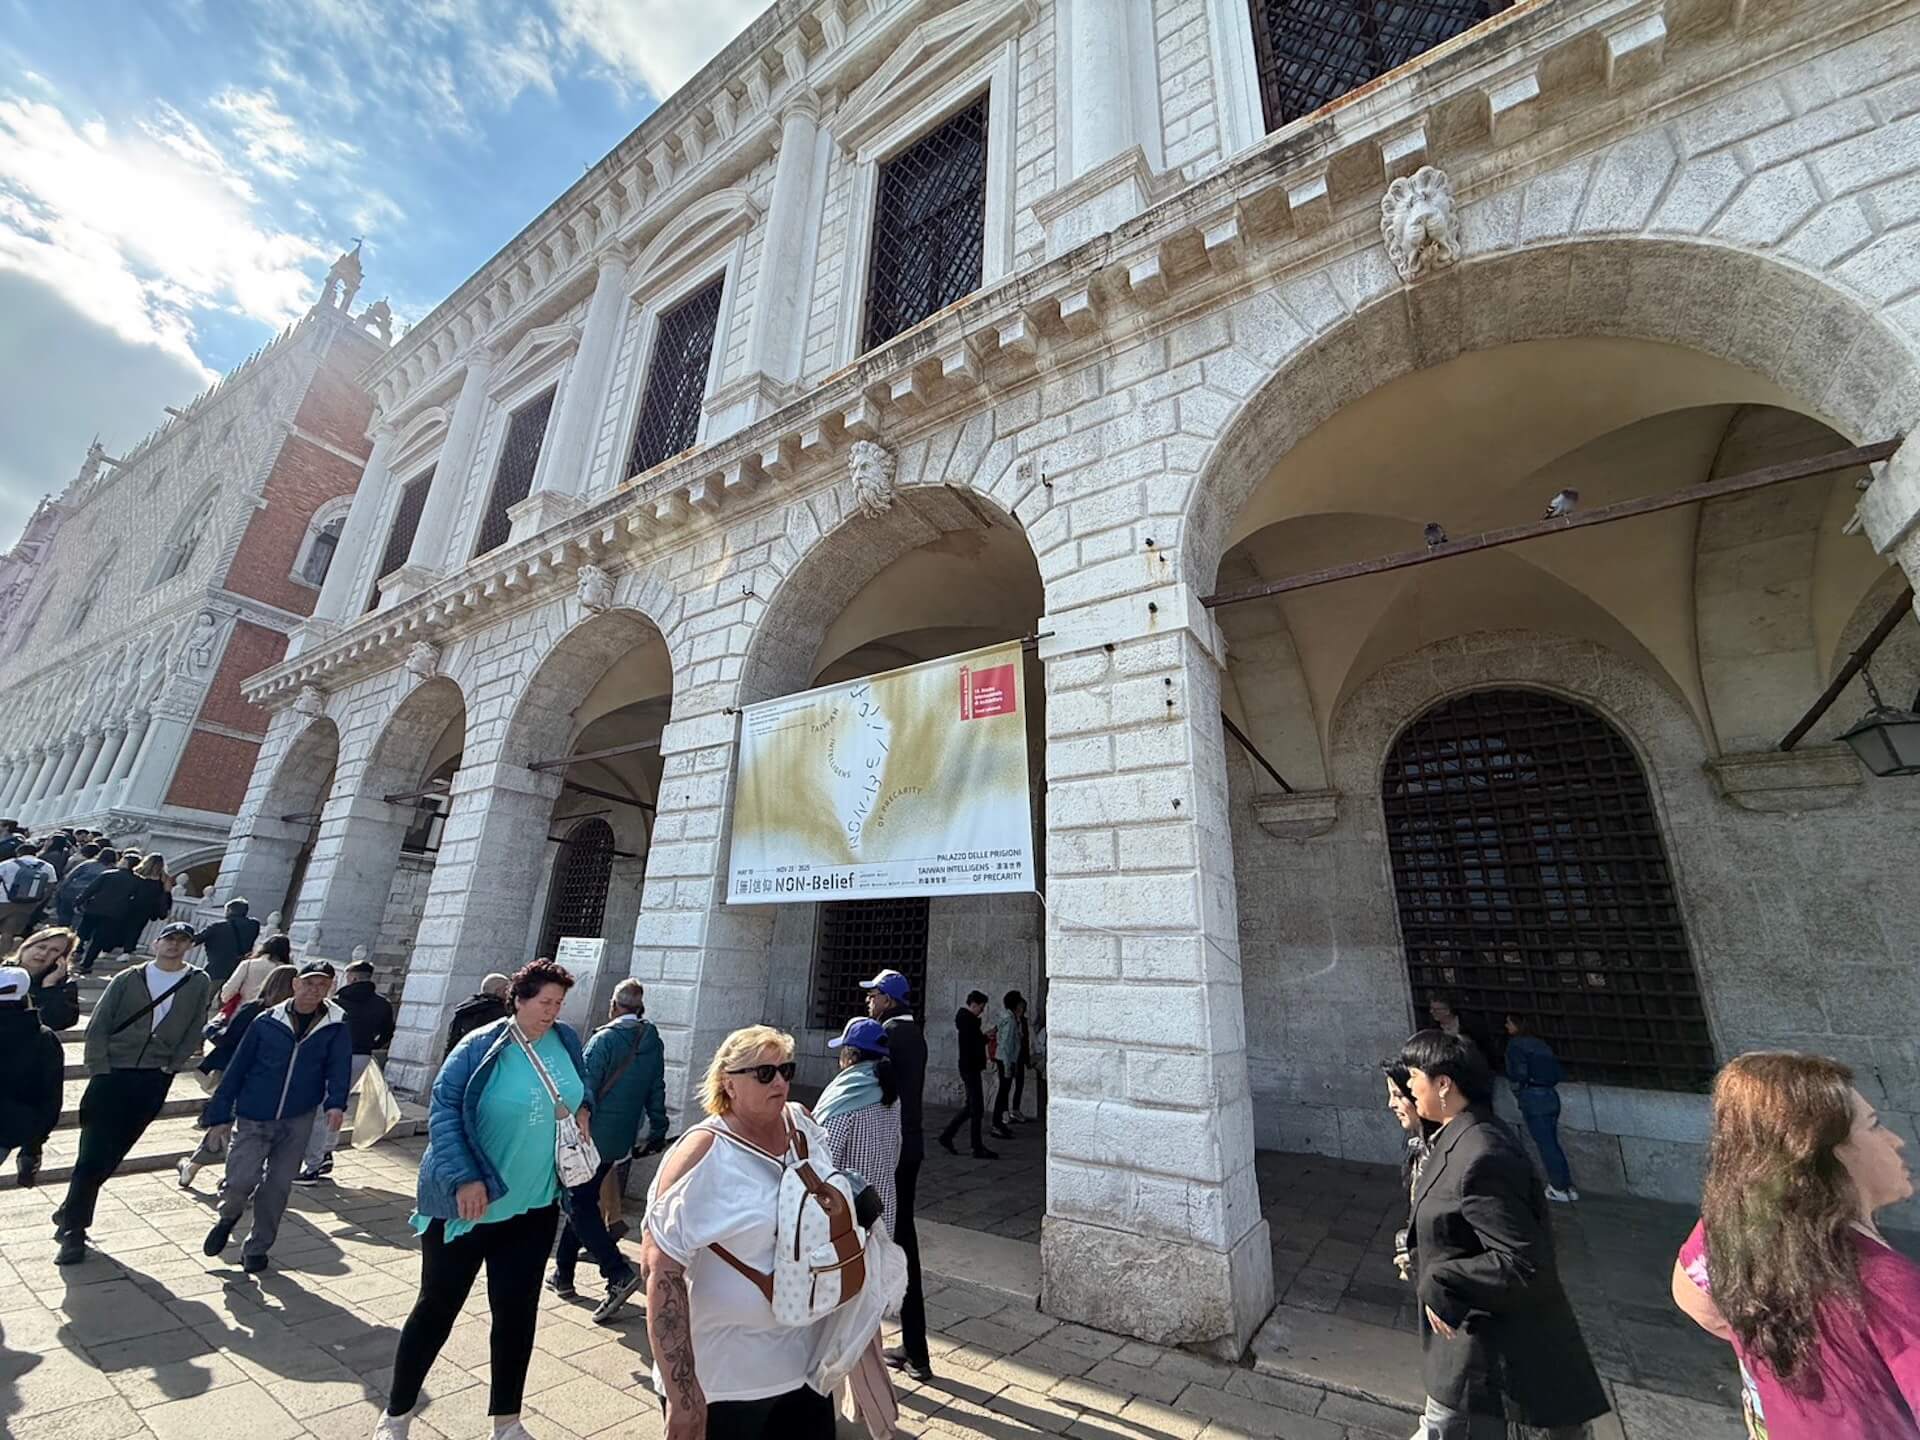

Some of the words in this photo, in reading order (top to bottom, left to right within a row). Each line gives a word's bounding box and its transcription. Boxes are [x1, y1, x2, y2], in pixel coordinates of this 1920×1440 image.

[811, 707, 839, 733] TAIWAN
[881, 786, 922, 812] PRECARITY
[937, 852, 966, 861] PALAZZO
[968, 851, 988, 860] DELLE
[990, 849, 1022, 859] PRIGIONI
[918, 866, 945, 875] TAIWAN
[947, 863, 989, 873] INTELLIGENS
[973, 874, 982, 882] OF
[983, 872, 1023, 881] PRECARITY
[775, 872, 855, 892] NON-Belief
